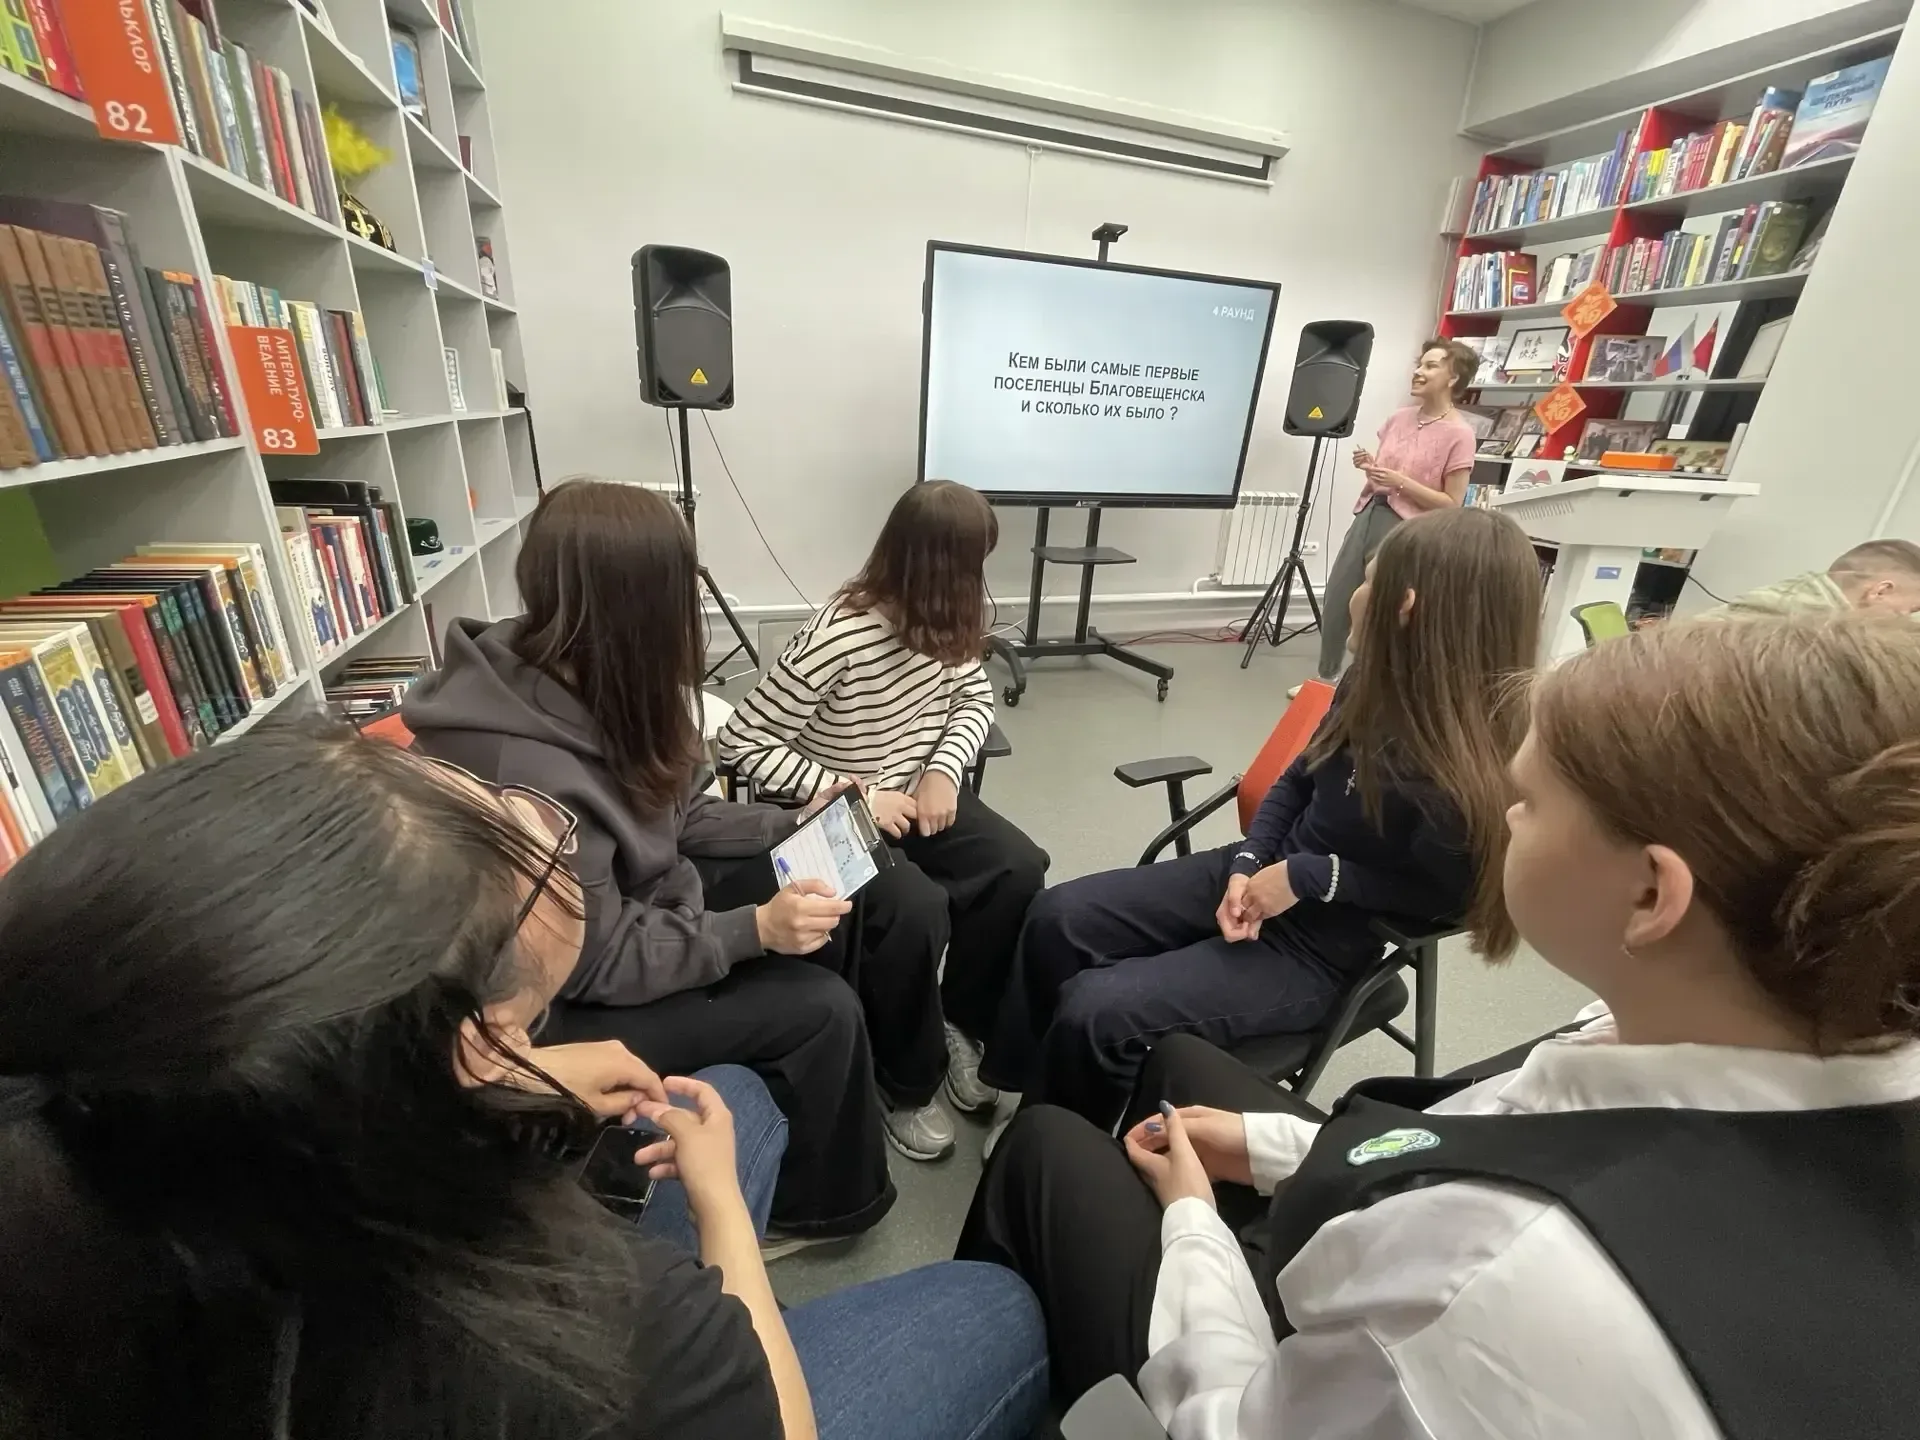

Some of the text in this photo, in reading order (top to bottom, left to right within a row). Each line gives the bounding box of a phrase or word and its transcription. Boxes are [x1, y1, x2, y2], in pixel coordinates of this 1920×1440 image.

[1823, 97, 1853, 109] ПУТЬ
[105, 100, 154, 135] 82
[1220, 306, 1255, 322] РАУНД
[256, 335, 283, 396] ВЕДЕНИЕ
[1044, 357, 1087, 373] БЫЛИ
[1090, 361, 1141, 377] САМЫЕ
[1144, 365, 1200, 381] ПЕРВЫЕ
[274, 335, 305, 425] ЛИТЕРАТУРО-
[993, 376, 1085, 396] ПОСЕЛЕНЦЫ
[1021, 400, 1179, 421] И СКОЛЬКО ИХ БЫЛО ?
[1544, 392, 1573, 422] 福
[263, 428, 297, 449] 83
